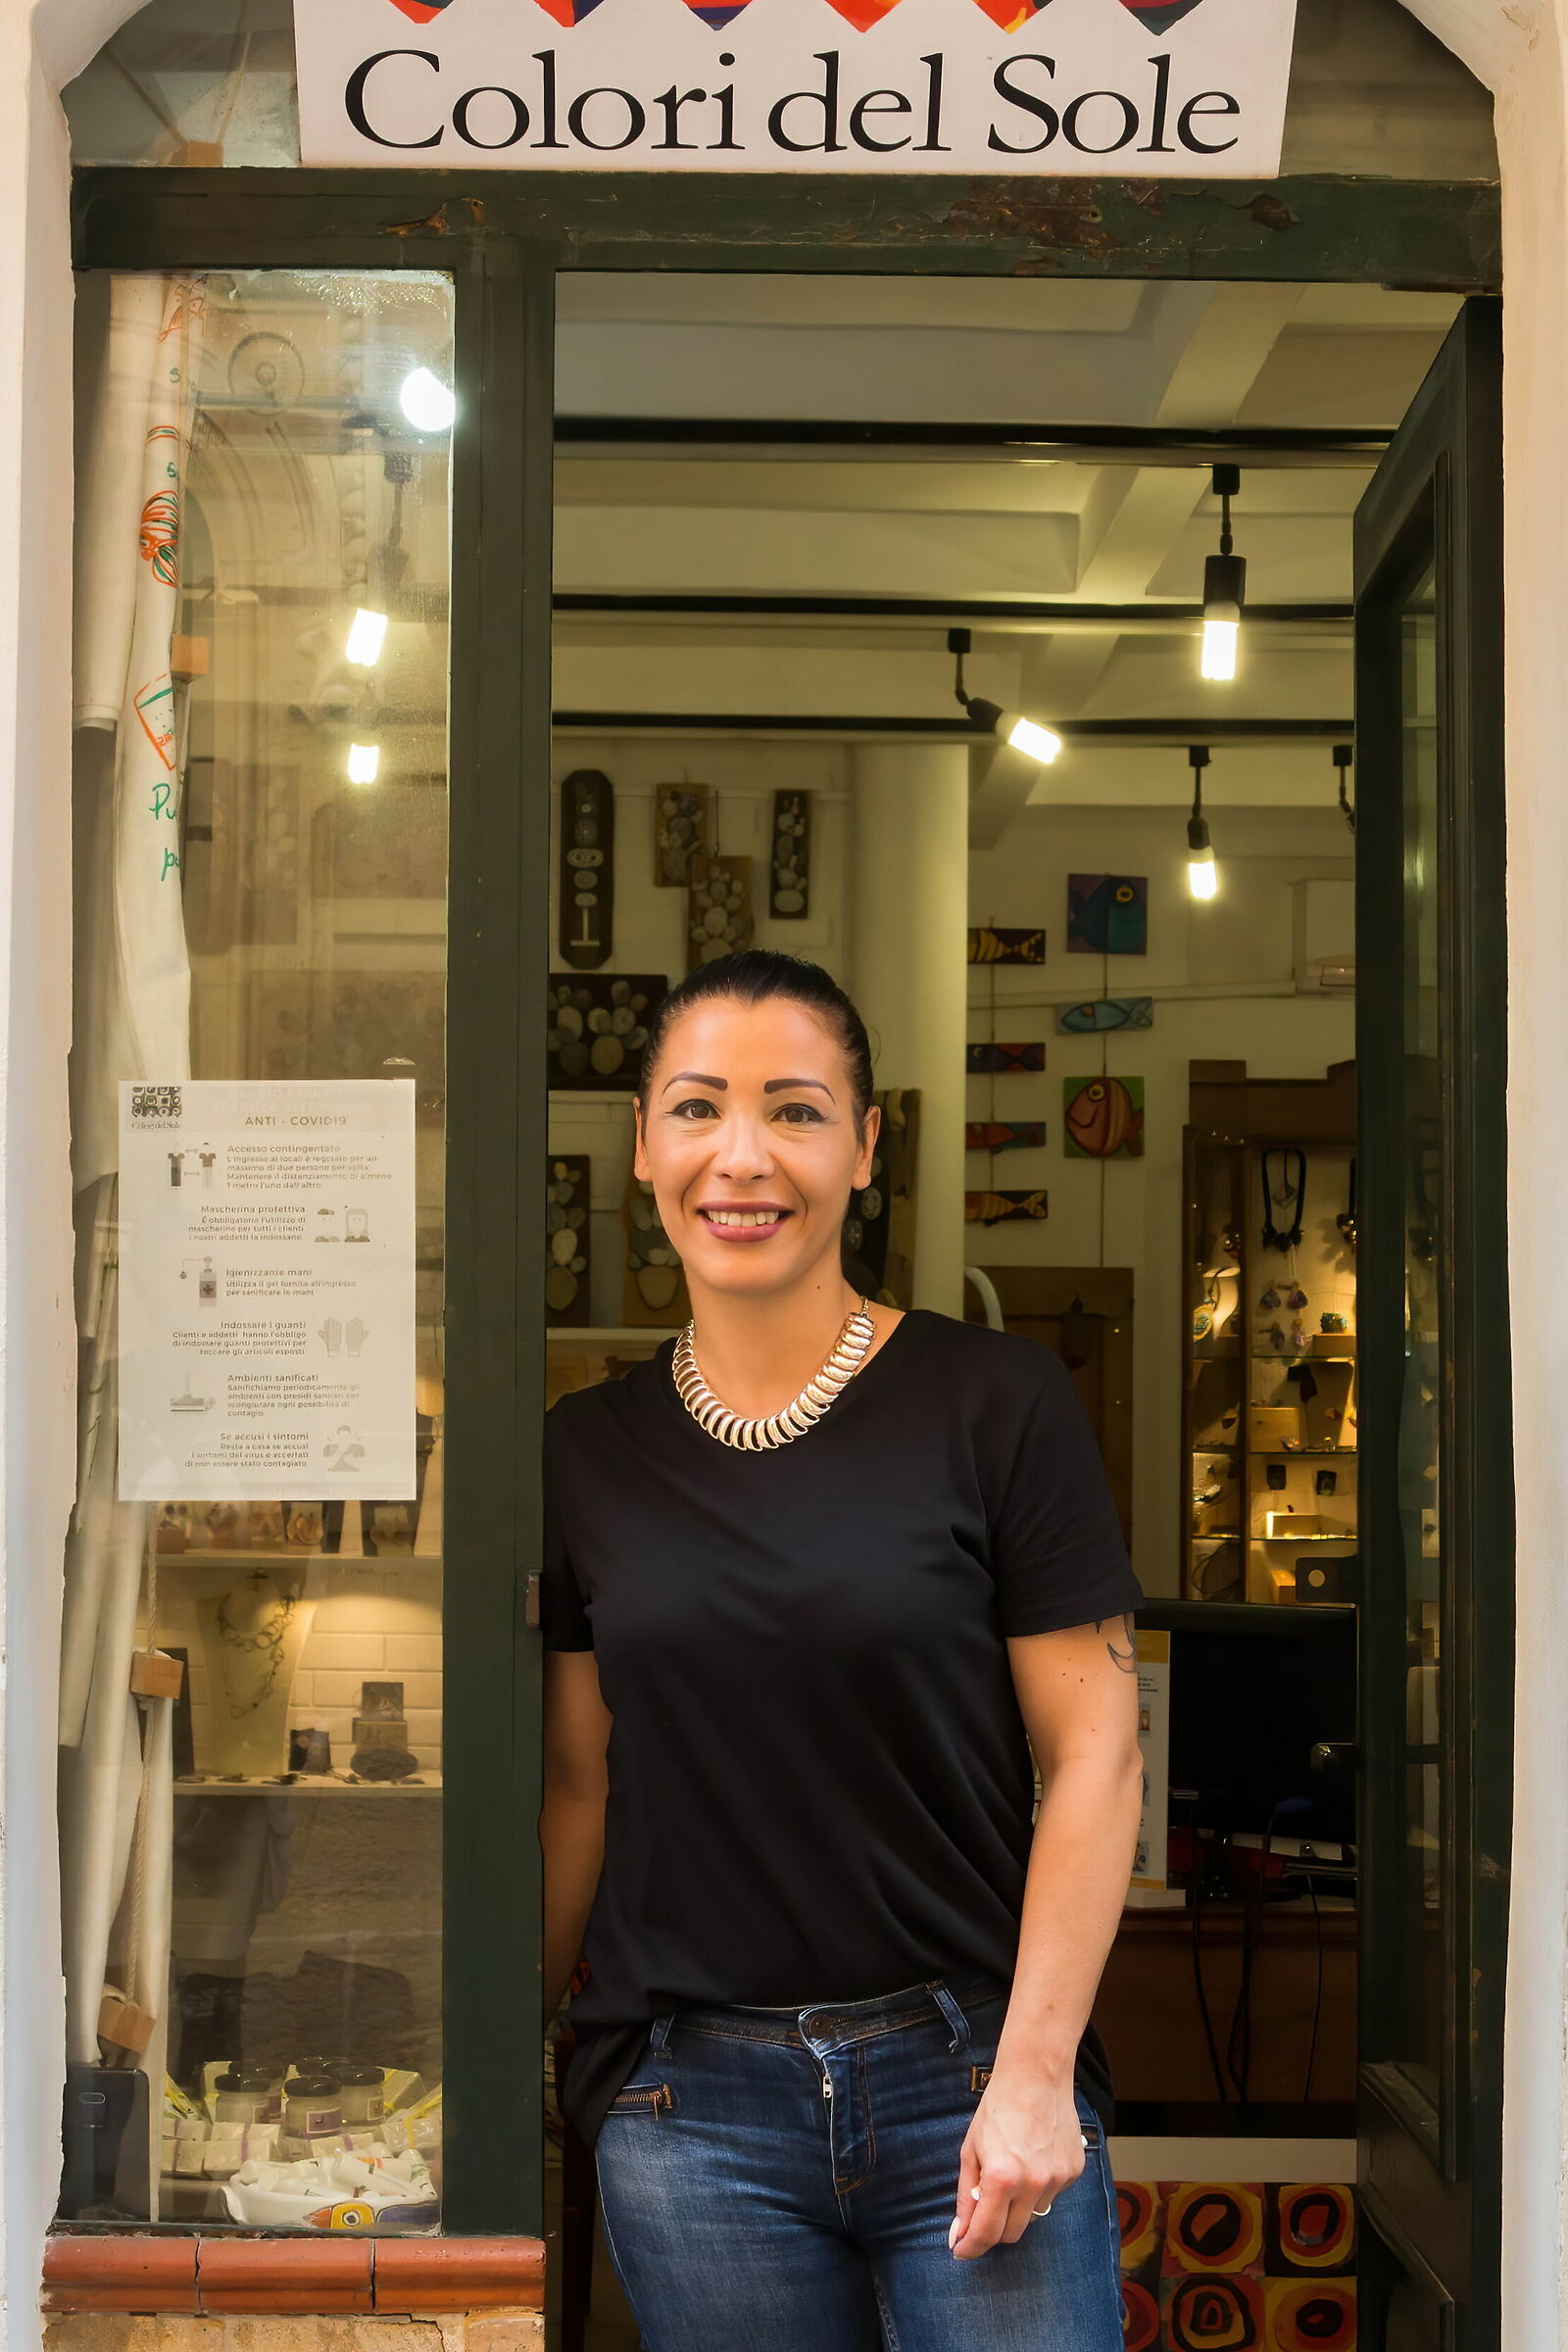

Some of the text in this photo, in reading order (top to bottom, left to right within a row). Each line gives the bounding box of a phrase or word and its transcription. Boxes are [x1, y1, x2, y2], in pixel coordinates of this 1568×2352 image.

[345, 50, 1240, 154] Colori del Sole
[245, 1116, 276, 1126] ANTI
[291, 1116, 346, 1126] COVID19
[270, 1145, 341, 1154] contingentato
[295, 1164, 329, 1173] persone
[227, 1173, 272, 1181] Mantenere
[282, 1173, 348, 1181] distanziamento
[360, 1173, 392, 1181] almeno
[258, 1205, 306, 1214] protettiva
[209, 1216, 259, 1225] obbligatorio
[226, 1270, 285, 1278] Igienizzante
[274, 1322, 306, 1331] guanti
[224, 1340, 250, 1348] guanti
[253, 1340, 291, 1348] protettivi
[283, 1384, 347, 1393] periodicamente
[284, 1393, 312, 1401] presidi
[277, 1401, 295, 1410] ogni
